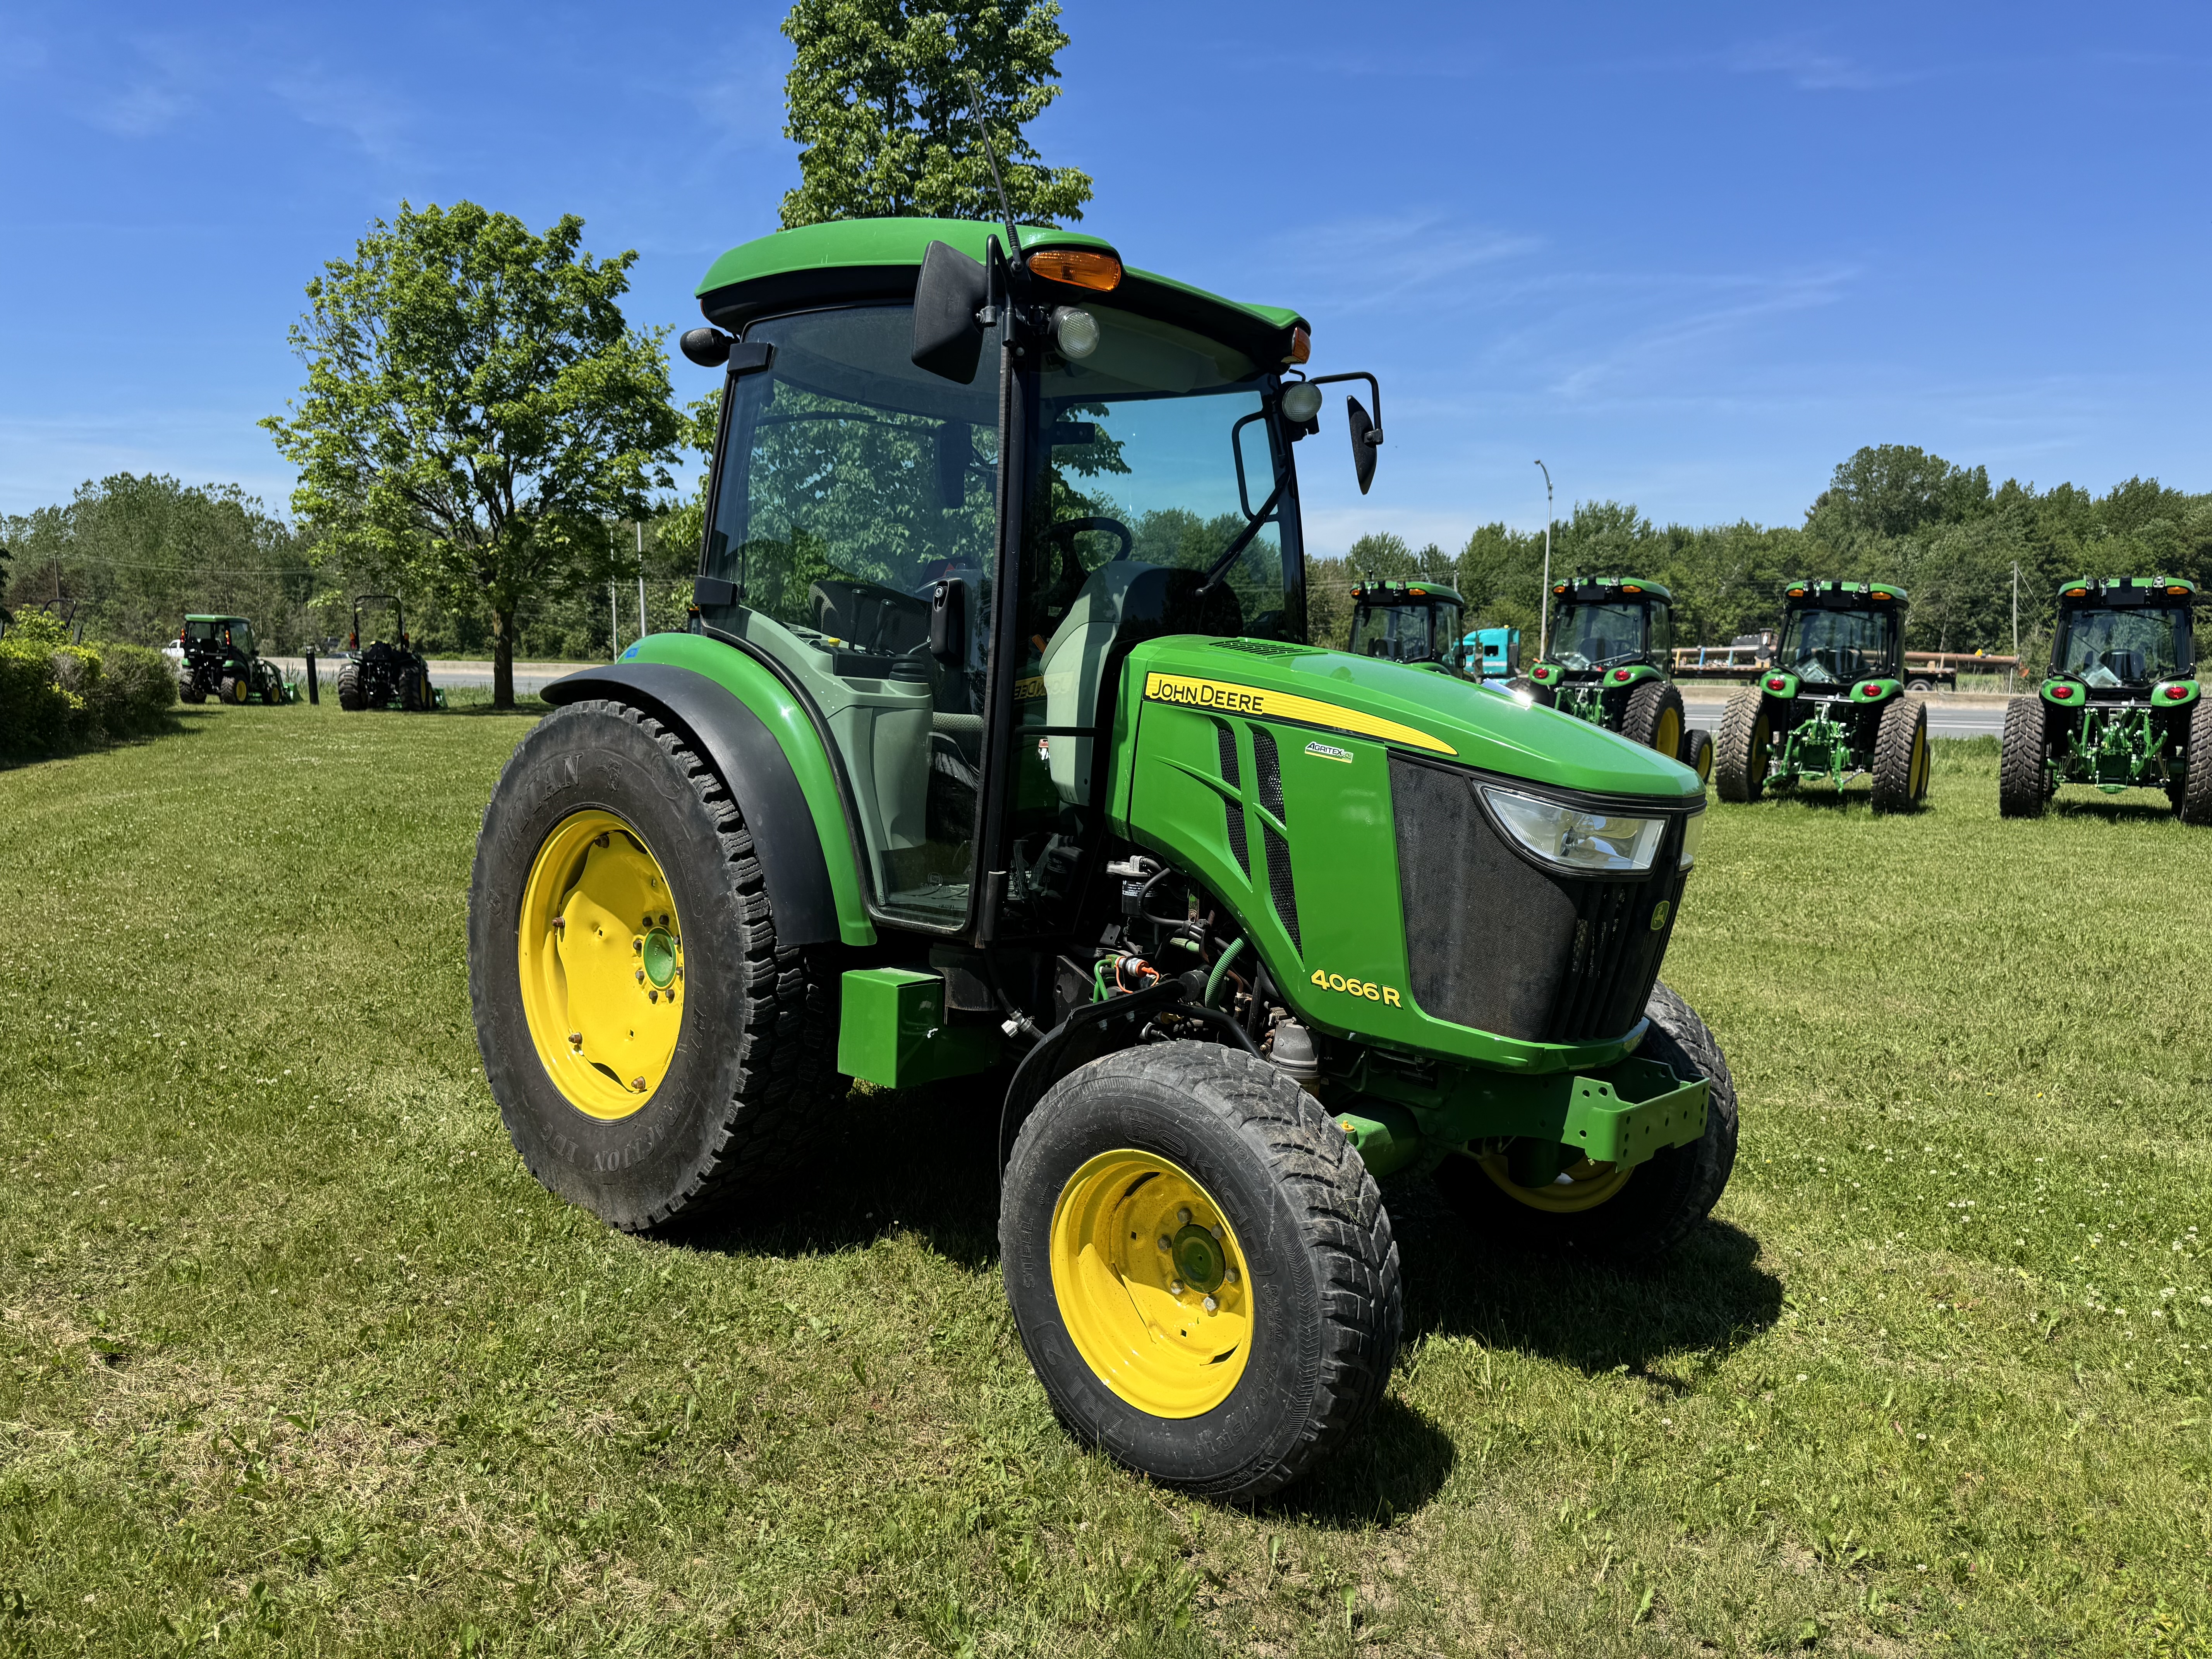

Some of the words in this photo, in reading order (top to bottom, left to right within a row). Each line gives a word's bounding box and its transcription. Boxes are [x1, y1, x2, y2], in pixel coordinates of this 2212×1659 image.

[1152, 679, 1197, 701] JOHN
[1200, 685, 1264, 712] DEERE
[1307, 743, 1343, 756] AGRITEX
[501, 752, 584, 854] TITAN
[1311, 969, 1402, 1008] 4066R
[1194, 1108, 1257, 1172] ROTATION
[1021, 1218, 1035, 1288] STEEL
[1270, 1284, 1283, 1342] RADIAL
[1042, 1334, 1066, 1365] 2
[1067, 1376, 1123, 1443] TRI
[1188, 1470, 1252, 1491] ROTATION
